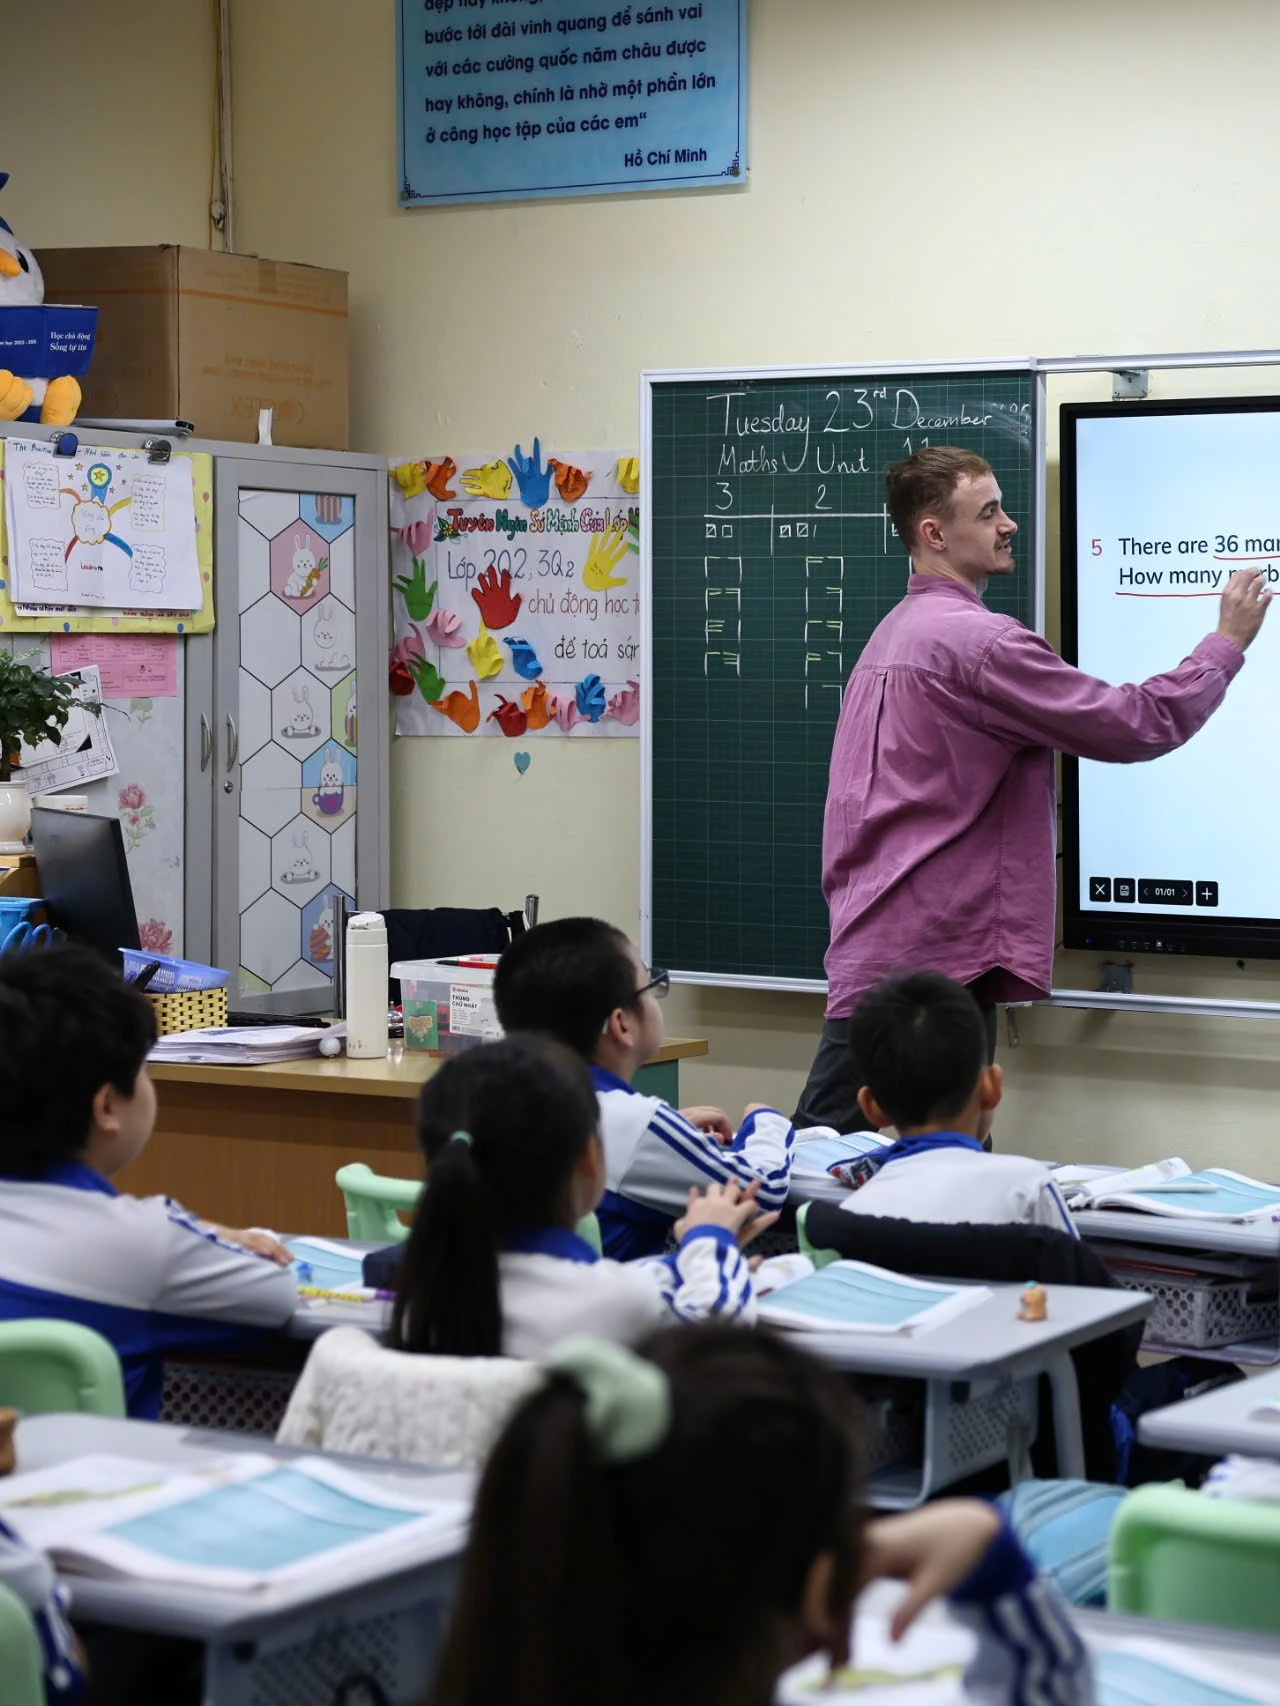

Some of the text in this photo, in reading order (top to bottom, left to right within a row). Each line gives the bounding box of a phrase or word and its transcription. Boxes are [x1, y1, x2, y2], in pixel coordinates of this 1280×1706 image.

[425, 4, 703, 44] bước tới đài vinh quang để sánh vai
[426, 38, 706, 77] với các cường quốc năm châu được
[425, 71, 716, 114] hay không, chính là nhờ một phần lớn
[426, 126, 436, 144] ở
[440, 123, 478, 144] công
[483, 121, 511, 141] học
[515, 118, 542, 139] tập
[546, 115, 576, 134] của
[580, 112, 610, 131] các
[624, 147, 707, 167] Hồ Chí Minh
[706, 391, 811, 472] Tuesday
[892, 389, 992, 430] December
[718, 443, 778, 476] Maths
[817, 446, 870, 474] Unit
[715, 482, 832, 510] 3 2
[1091, 538, 1103, 556] 5
[1118, 537, 1172, 556] There
[1177, 540, 1208, 554] are
[1214, 535, 1239, 553] 36
[1119, 567, 1163, 585] How
[1169, 570, 1222, 588] many
[528, 588, 554, 614] chủ
[560, 587, 598, 621] động
[605, 588, 629, 618] học
[554, 635, 576, 659] để
[1155, 886, 1176, 898] 01/01
